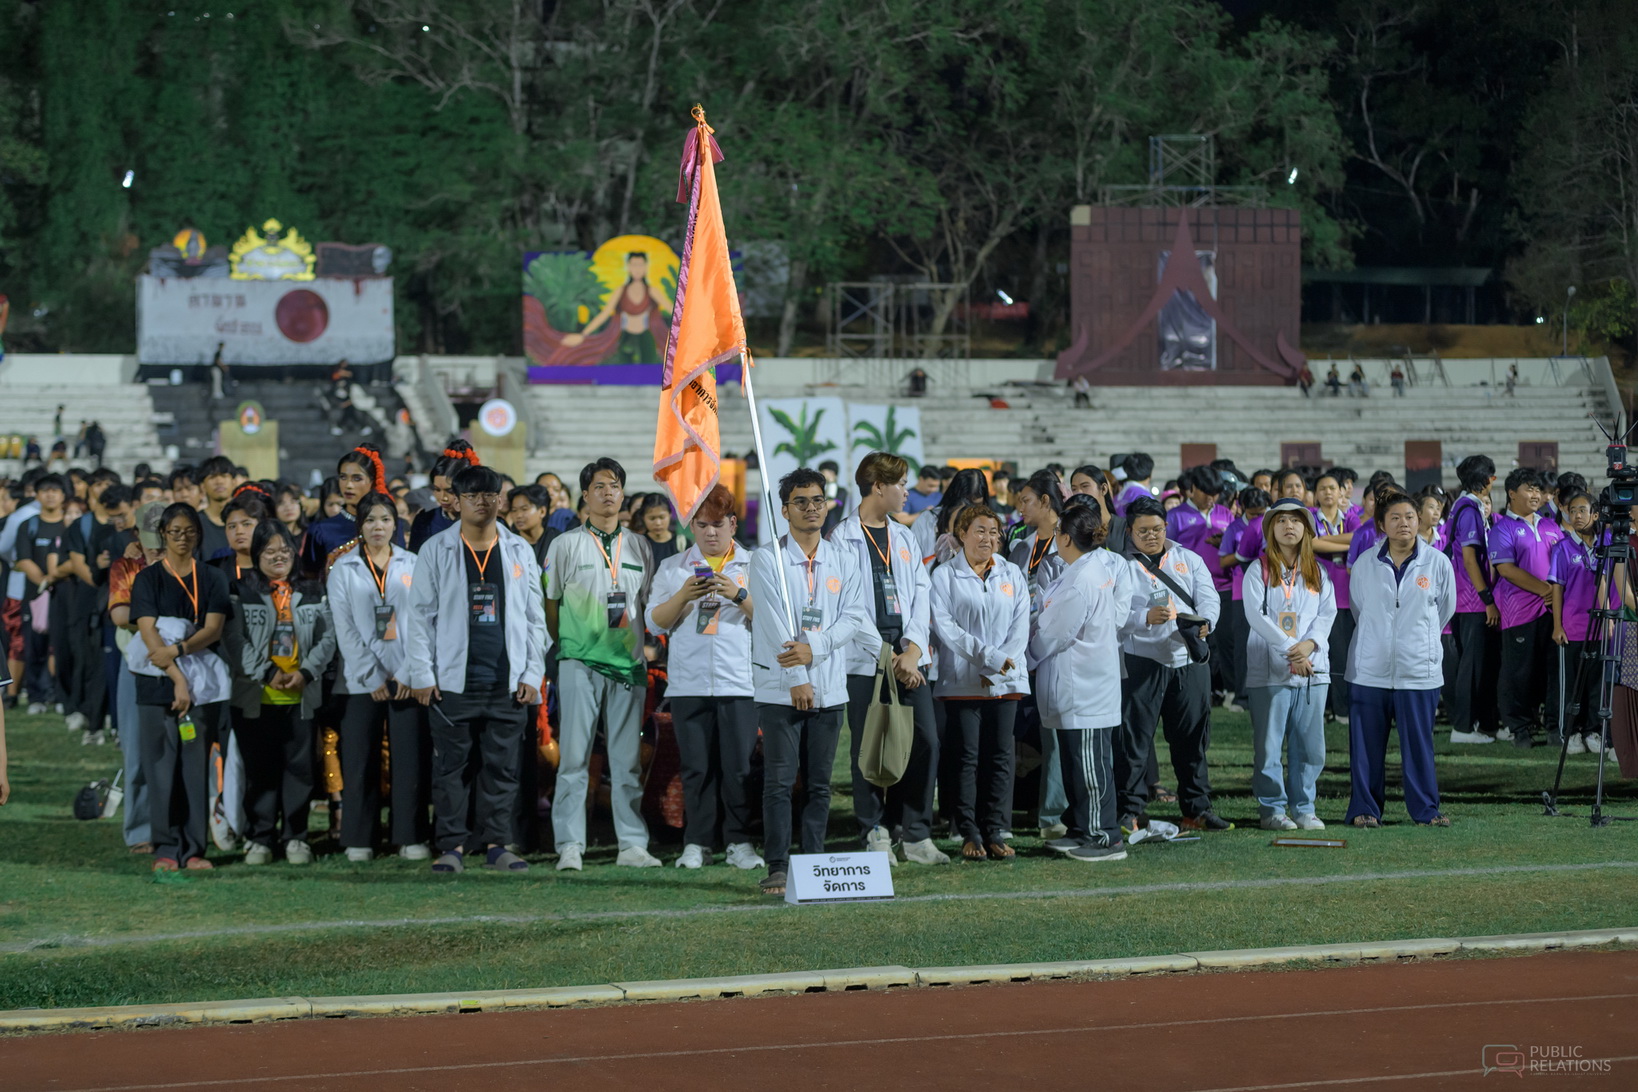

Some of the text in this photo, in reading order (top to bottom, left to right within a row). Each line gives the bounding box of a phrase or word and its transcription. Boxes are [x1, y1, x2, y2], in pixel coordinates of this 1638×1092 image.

[812, 864, 871, 877] วิทยาการ
[823, 880, 866, 892] จัดการ
